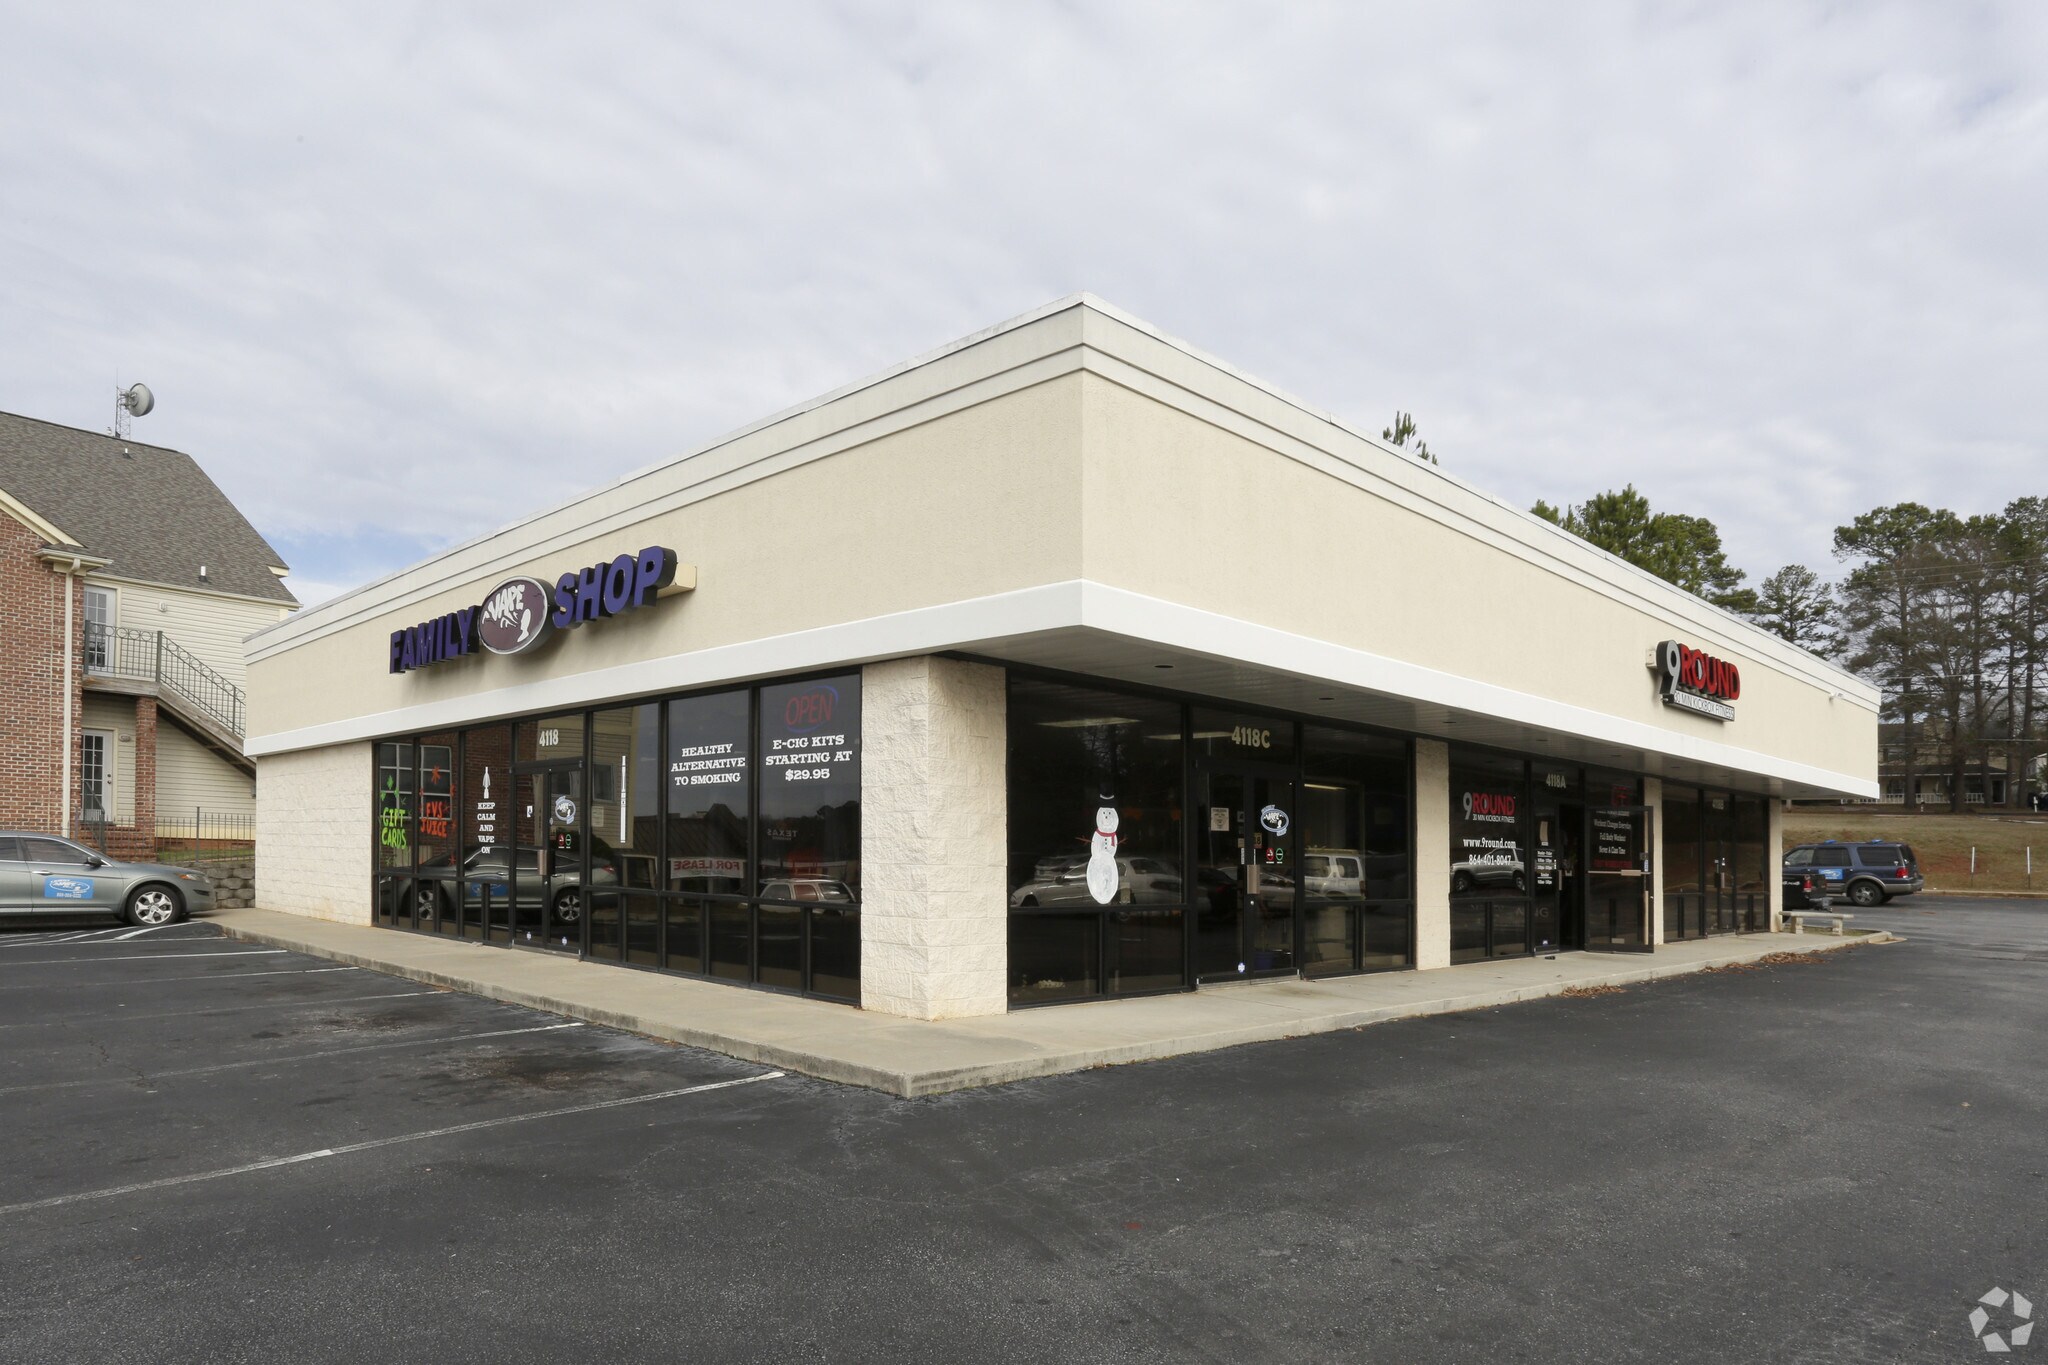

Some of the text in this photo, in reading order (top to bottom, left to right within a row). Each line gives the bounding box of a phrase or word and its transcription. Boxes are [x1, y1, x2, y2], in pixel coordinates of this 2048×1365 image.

[390, 546, 668, 674] FAMILY VAPE SHOP
[1664, 639, 1741, 700] 9ROUND
[1681, 693, 1692, 707] MIN
[785, 694, 834, 726] OPEN
[539, 729, 559, 747] 4118
[773, 734, 845, 750] E-CIG KITS
[1231, 725, 1271, 749] 4118C
[681, 743, 733, 758] HEALTHY
[765, 750, 853, 766] STARTING AT
[671, 757, 746, 772] ALTERNATIVE
[674, 772, 741, 786] TO SMOKING
[785, 768, 830, 781] $29.95
[1546, 773, 1567, 789] 4118A
[477, 802, 496, 810] KEEP
[1463, 792, 1515, 820] 9ROUND
[383, 807, 406, 828] GIFT
[477, 813, 496, 821] CALM
[421, 818, 449, 838] JUICE
[479, 824, 494, 832] AND
[381, 827, 407, 850] CARDS
[477, 835, 495, 843] VAPE
[1463, 837, 1516, 849] www.9round.com
[481, 846, 491, 854] ON
[1468, 854, 1512, 865] 864-401-8047
